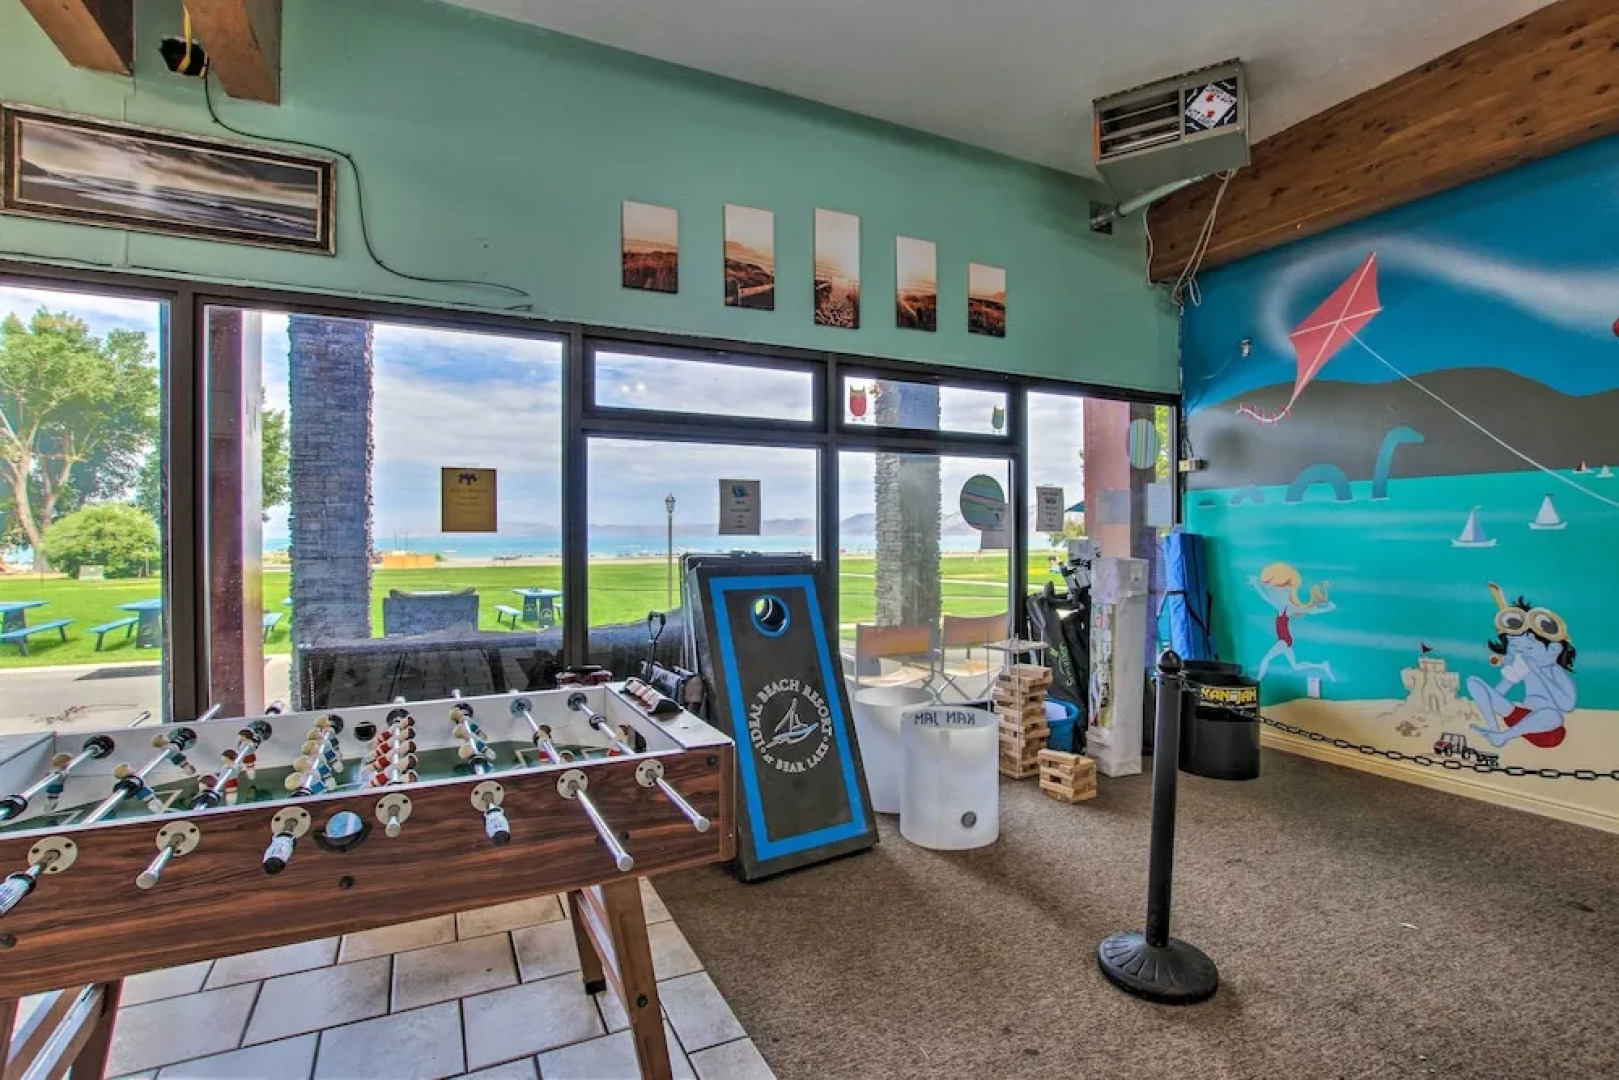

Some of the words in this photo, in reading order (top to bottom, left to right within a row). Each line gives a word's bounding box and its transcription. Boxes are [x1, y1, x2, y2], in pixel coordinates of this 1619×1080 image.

[757, 679, 801, 703] BEACH
[802, 684, 832, 736] RESORT
[749, 703, 766, 748] IDEAL
[775, 759, 806, 773] BEAR
[806, 742, 830, 768] LAKE
